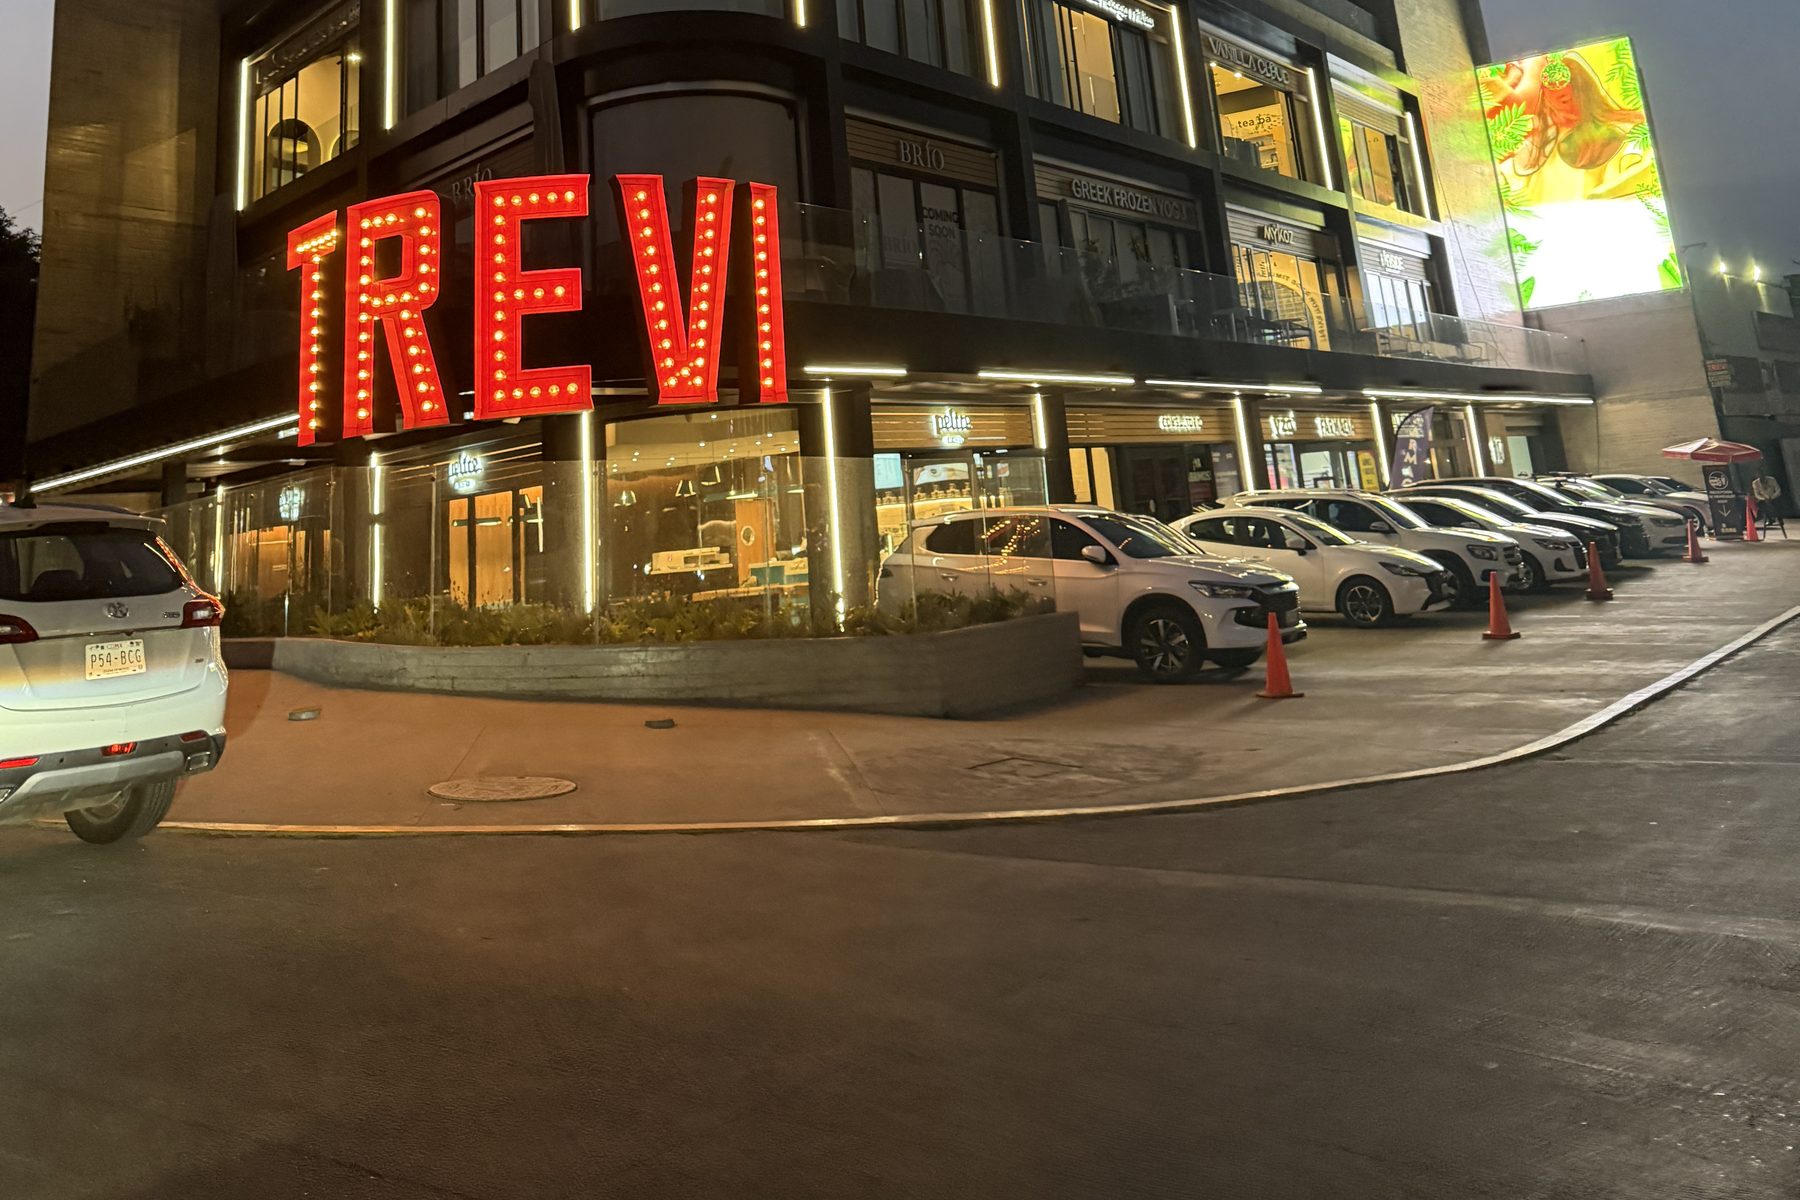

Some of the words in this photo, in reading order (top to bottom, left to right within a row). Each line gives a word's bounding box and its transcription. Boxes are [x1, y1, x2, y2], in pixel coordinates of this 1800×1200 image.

[1208, 36, 1257, 72] VANILLA
[1237, 118, 1255, 128] tea
[1071, 179, 1112, 206] GREEK
[1113, 188, 1158, 215] FROZEN
[287, 173, 789, 447] TREVI
[90, 648, 142, 670] P54-BCG
